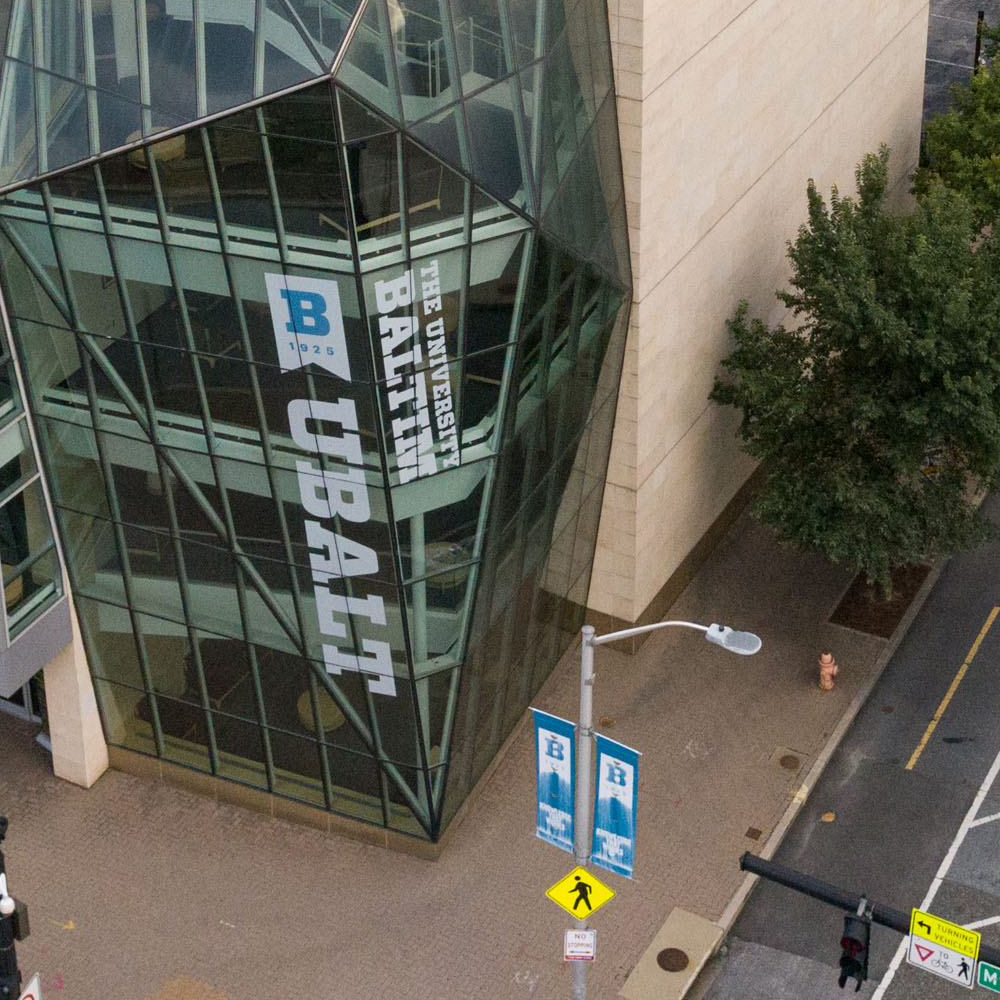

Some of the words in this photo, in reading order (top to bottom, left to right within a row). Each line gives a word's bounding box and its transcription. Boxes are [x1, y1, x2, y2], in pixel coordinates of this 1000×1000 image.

[420, 259, 442, 315] THE
[280, 288, 331, 337] B
[289, 341, 335, 356] 1925
[426, 317, 461, 468] UNIVERSITY
[287, 396, 397, 697] UBALT
[545, 737, 565, 761] B
[606, 763, 627, 787] B
[934, 933, 974, 954] VEHICLES
[937, 923, 974, 943] TURNING
[939, 950, 949, 960] TO
[983, 968, 1000, 986] M
